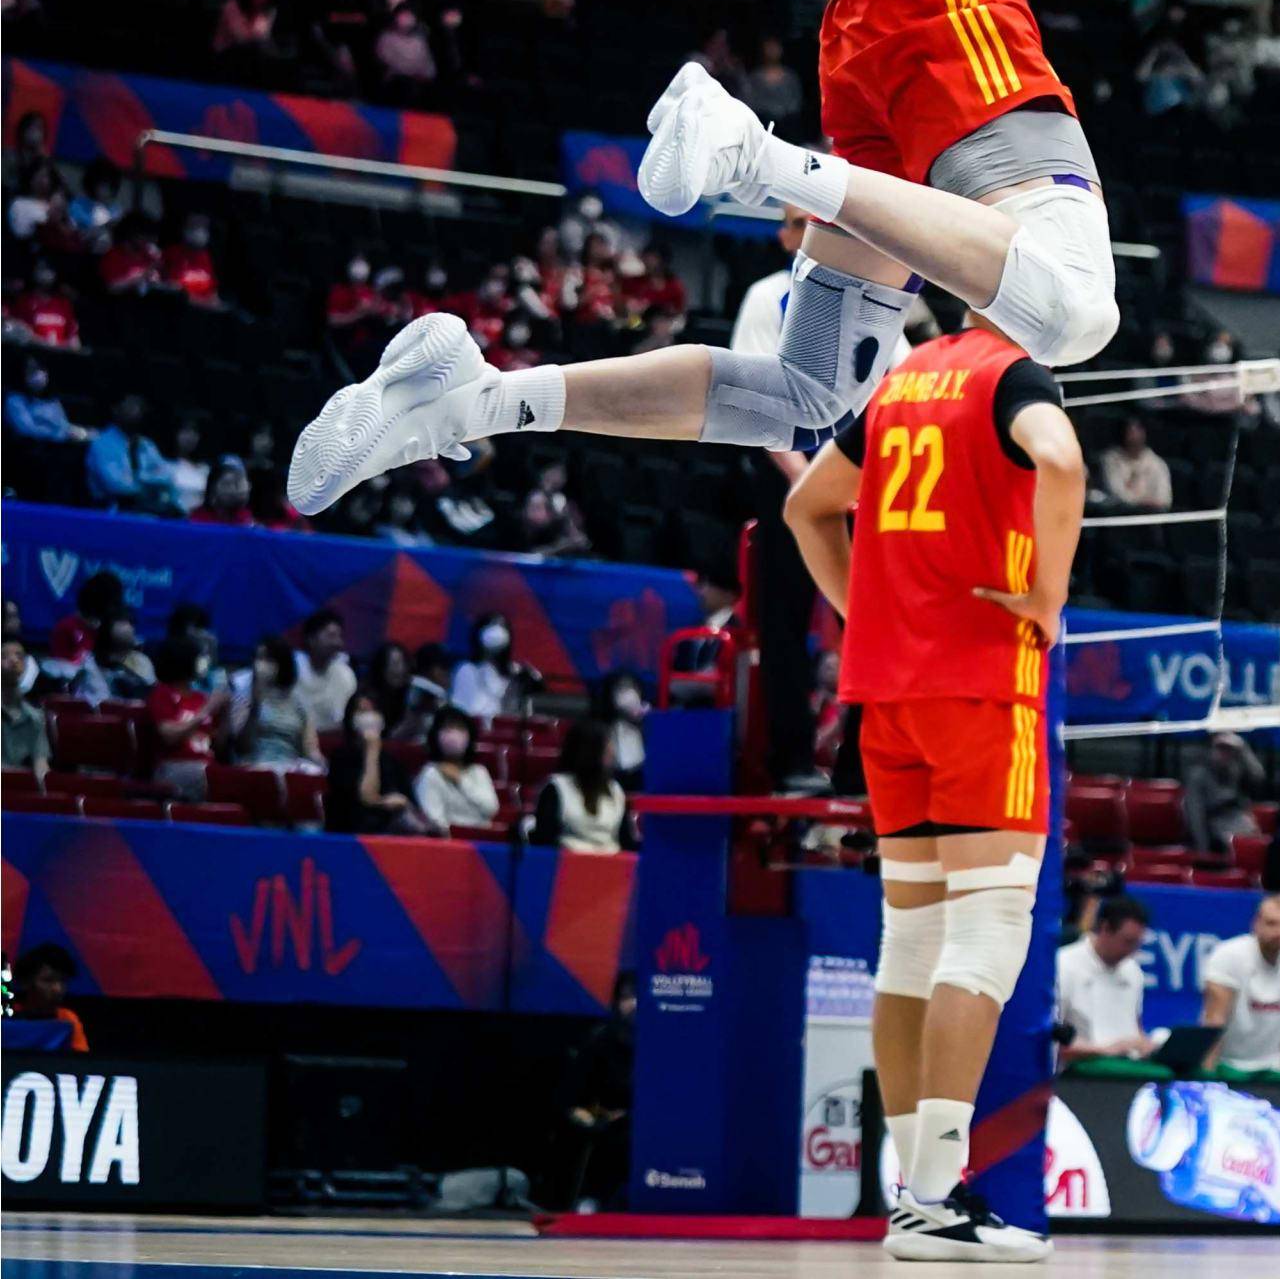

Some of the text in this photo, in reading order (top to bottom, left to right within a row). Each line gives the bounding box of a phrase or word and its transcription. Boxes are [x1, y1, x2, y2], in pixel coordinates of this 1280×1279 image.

[879, 424, 946, 532] 22
[229, 856, 364, 975] VNL
[1, 1071, 140, 1185] OYA
